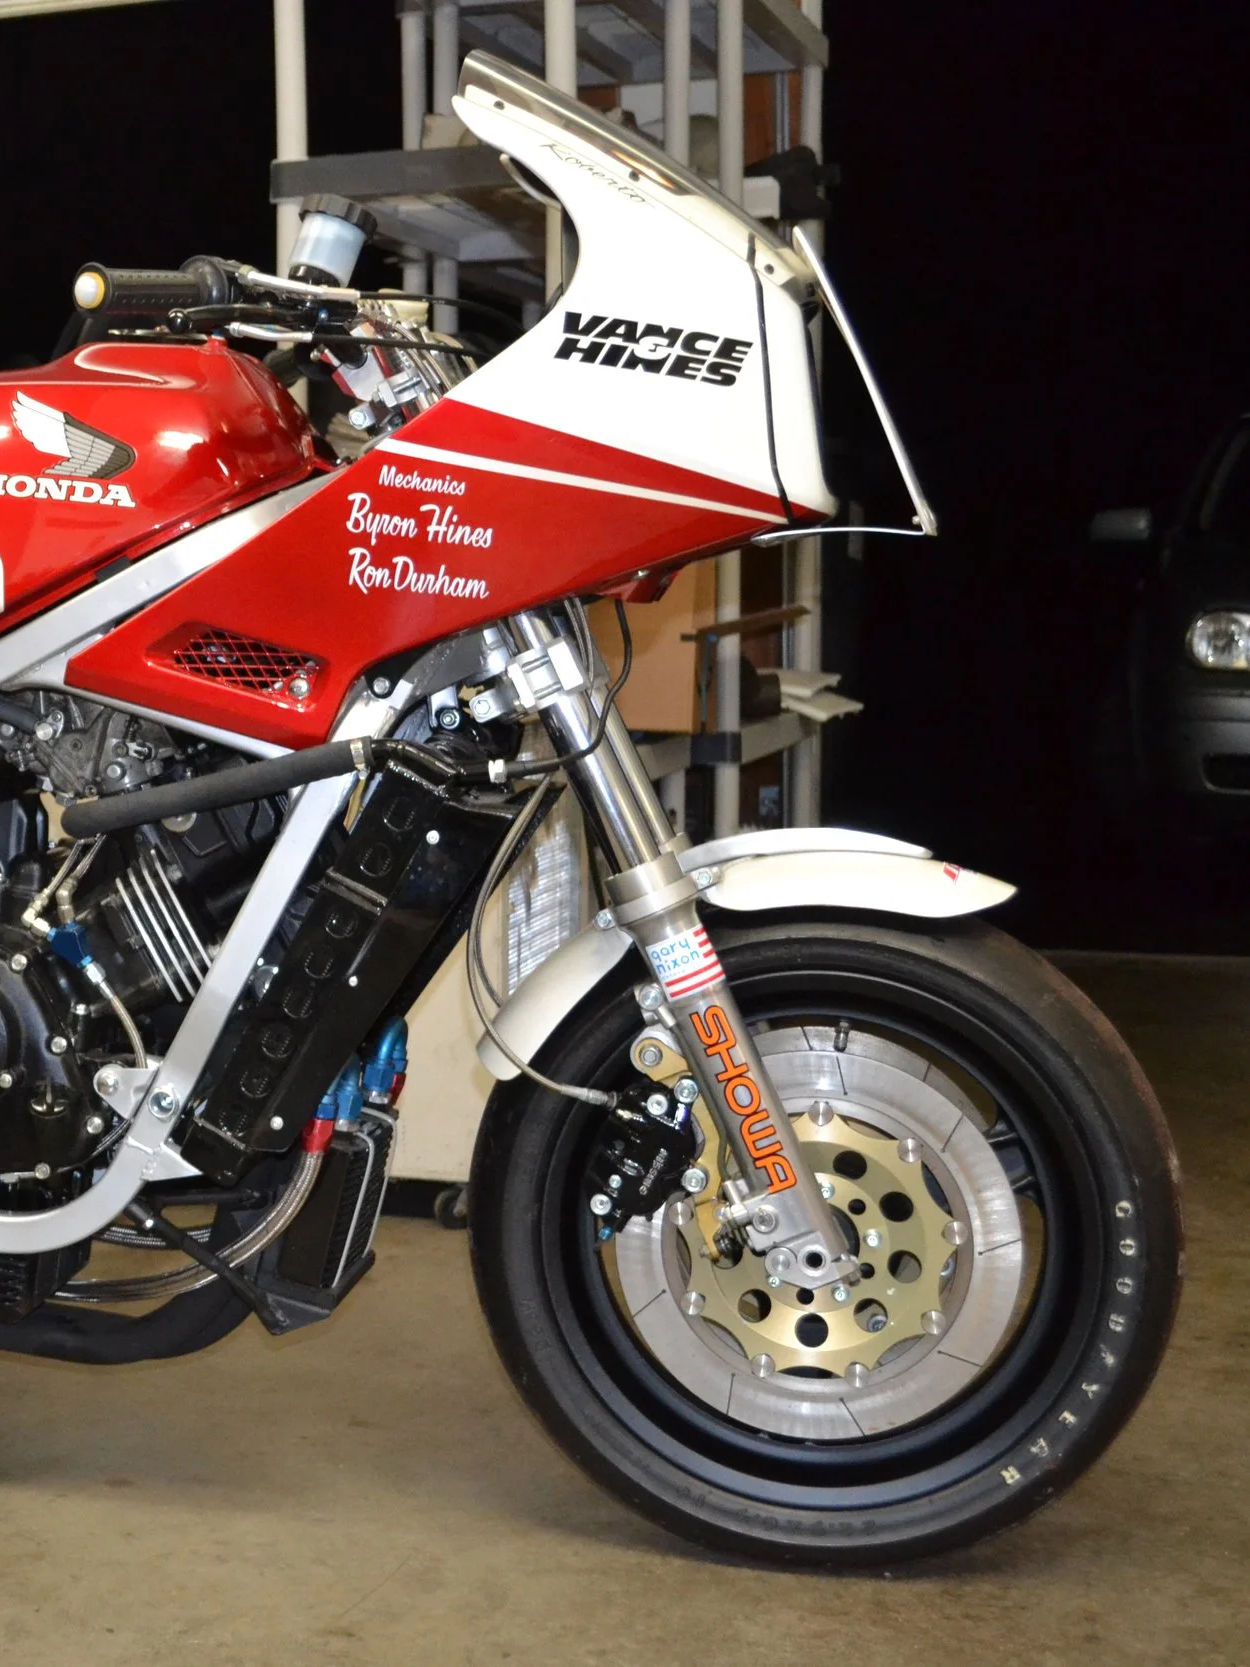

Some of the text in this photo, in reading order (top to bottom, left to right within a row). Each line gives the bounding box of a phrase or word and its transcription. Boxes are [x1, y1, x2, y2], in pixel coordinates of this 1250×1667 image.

[554, 337, 742, 386] HINES
[563, 311, 753, 363] VANCE
[378, 464, 466, 496] Mechanics
[346, 492, 493, 548] Byron Hines
[348, 547, 489, 599] Ron Durham
[651, 938, 691, 961] gary
[656, 950, 700, 974] nixon
[690, 1005, 798, 1194] SHOWA
